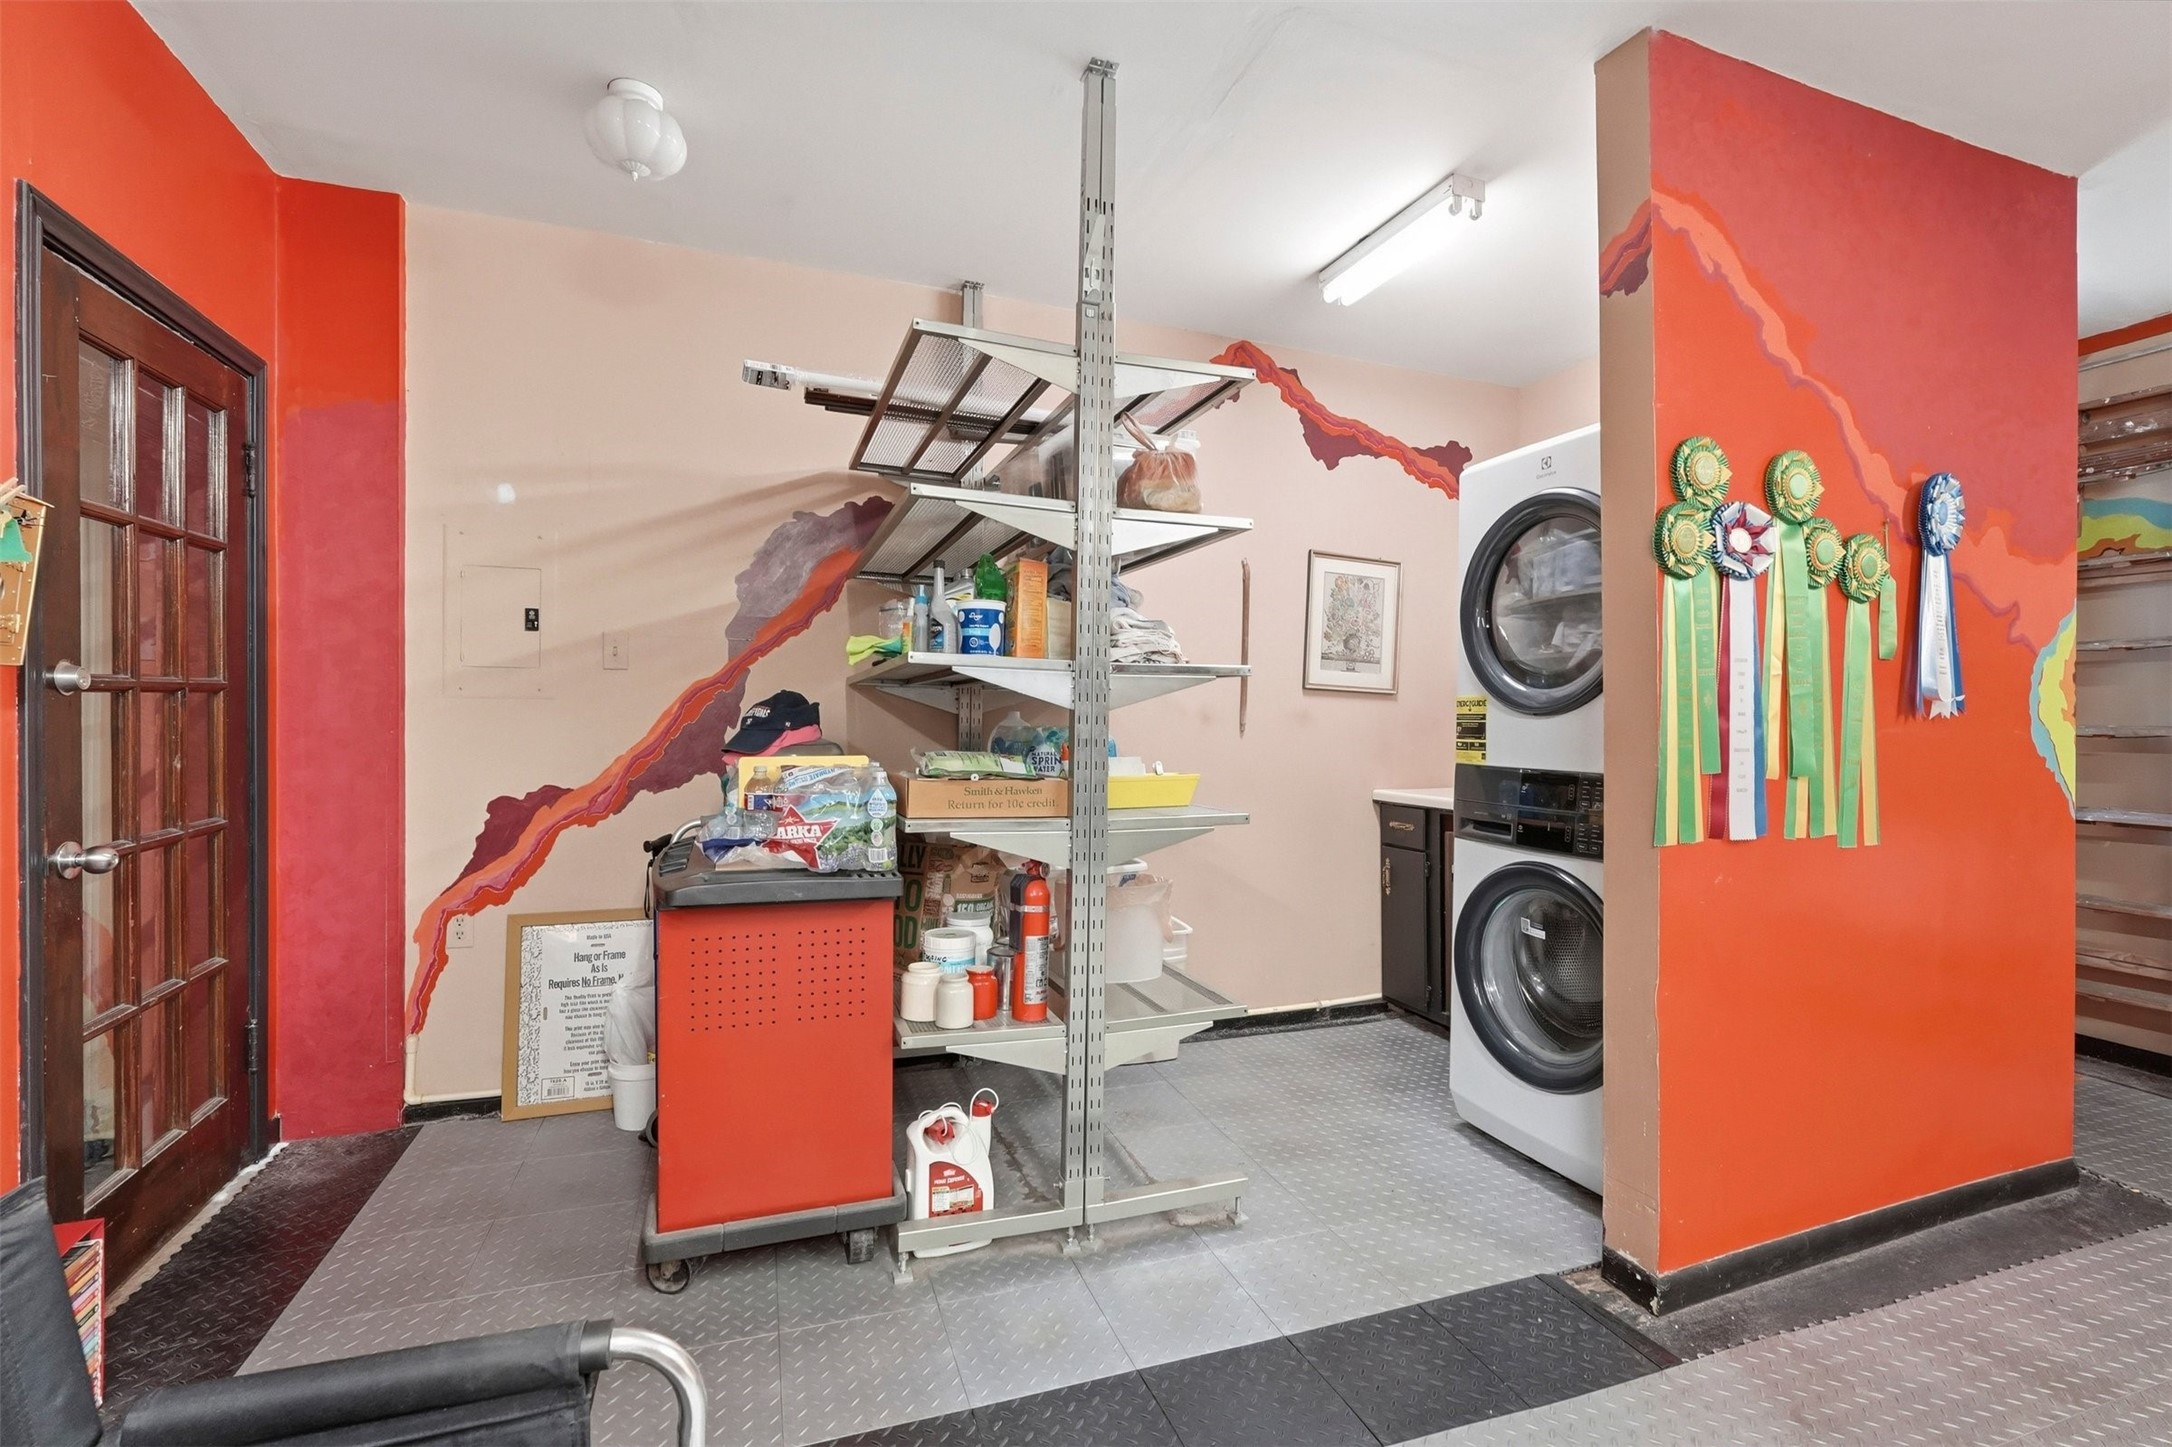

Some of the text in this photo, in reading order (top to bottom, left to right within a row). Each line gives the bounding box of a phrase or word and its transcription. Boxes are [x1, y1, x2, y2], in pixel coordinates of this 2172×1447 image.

[1032, 756, 1062, 765] SPRIN
[964, 786, 1043, 796] Smith & Hawken
[948, 800, 984, 810] Return
[988, 800, 1003, 809] for
[777, 824, 822, 838] ARKA
[574, 952, 593, 963] Hang
[603, 950, 626, 960] Frame
[591, 963, 608, 973] As Is
[548, 978, 580, 990] Requires
[582, 976, 591, 986] No
